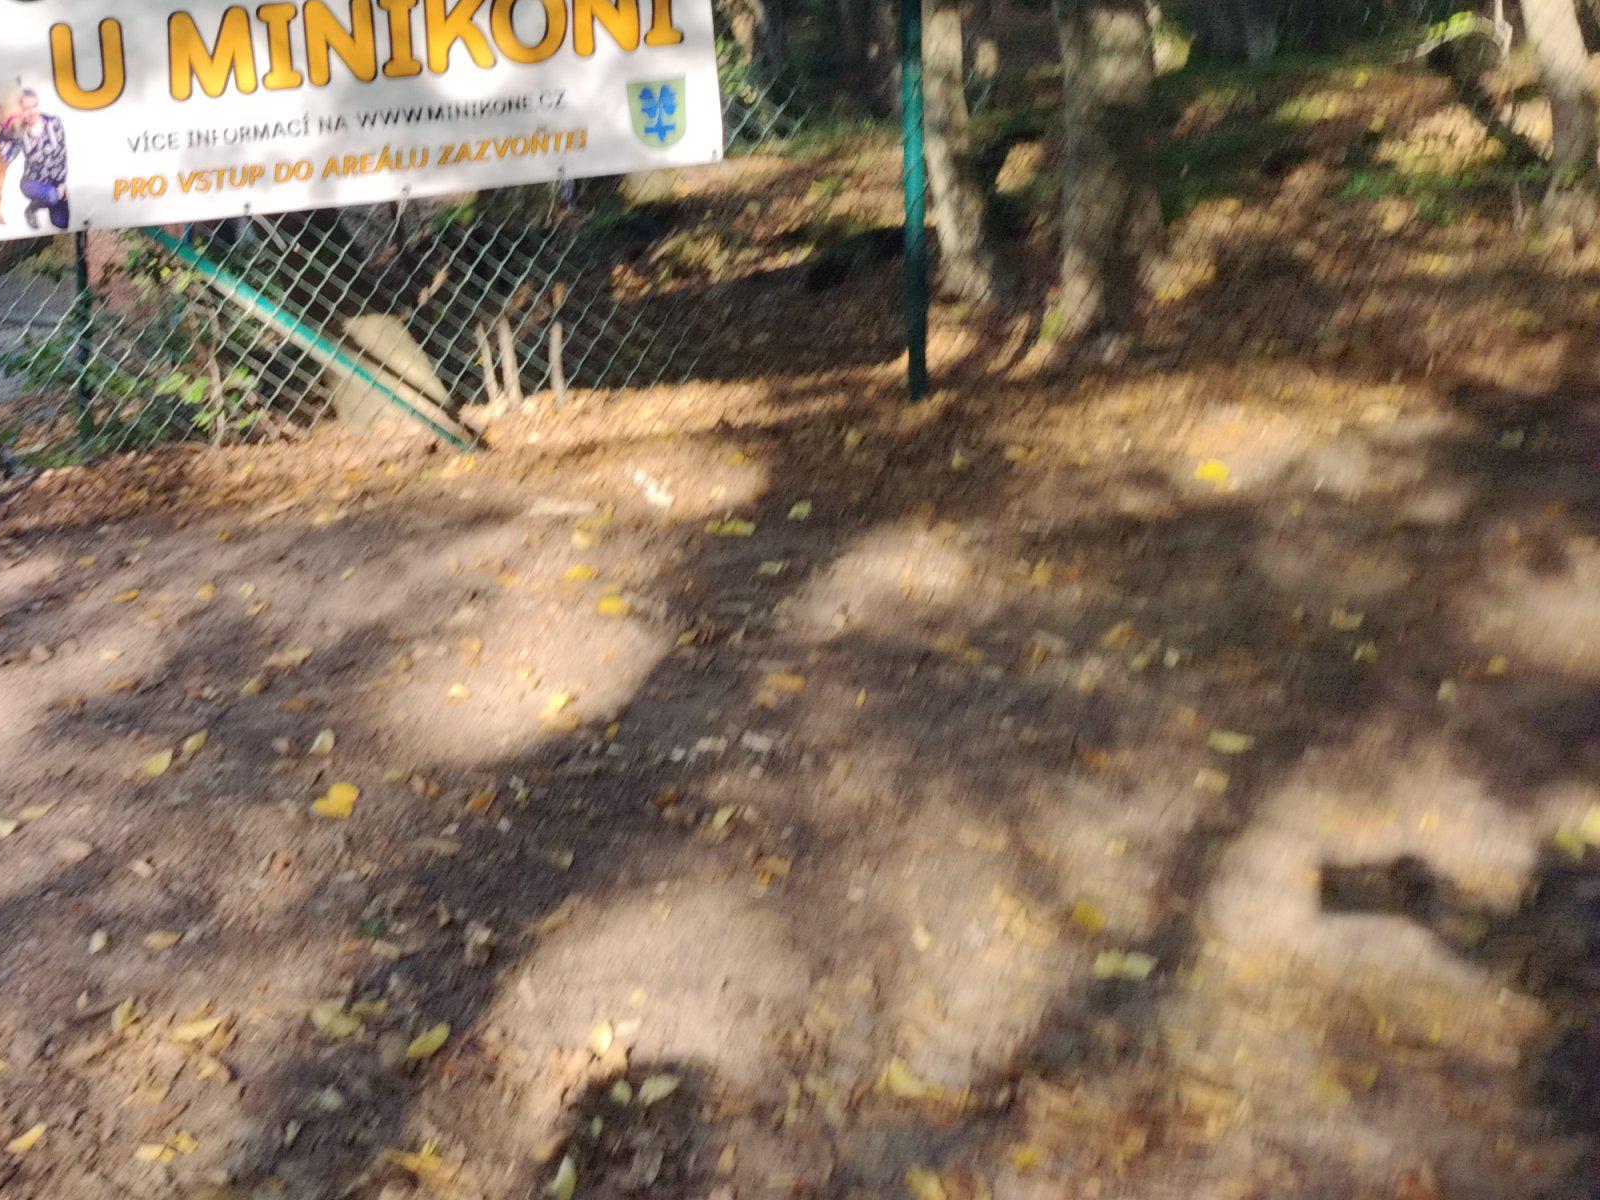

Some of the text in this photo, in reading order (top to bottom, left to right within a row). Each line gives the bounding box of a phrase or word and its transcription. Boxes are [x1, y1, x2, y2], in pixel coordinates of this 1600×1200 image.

[50, 17, 125, 111] U
[127, 126, 179, 153] VÍCE
[186, 109, 309, 150] INFORMACÍ
[318, 114, 348, 135] NA
[113, 175, 168, 201] PRO
[177, 163, 265, 193] VSTUP
[274, 159, 313, 184] DO
[321, 143, 429, 178] AREÁLU
